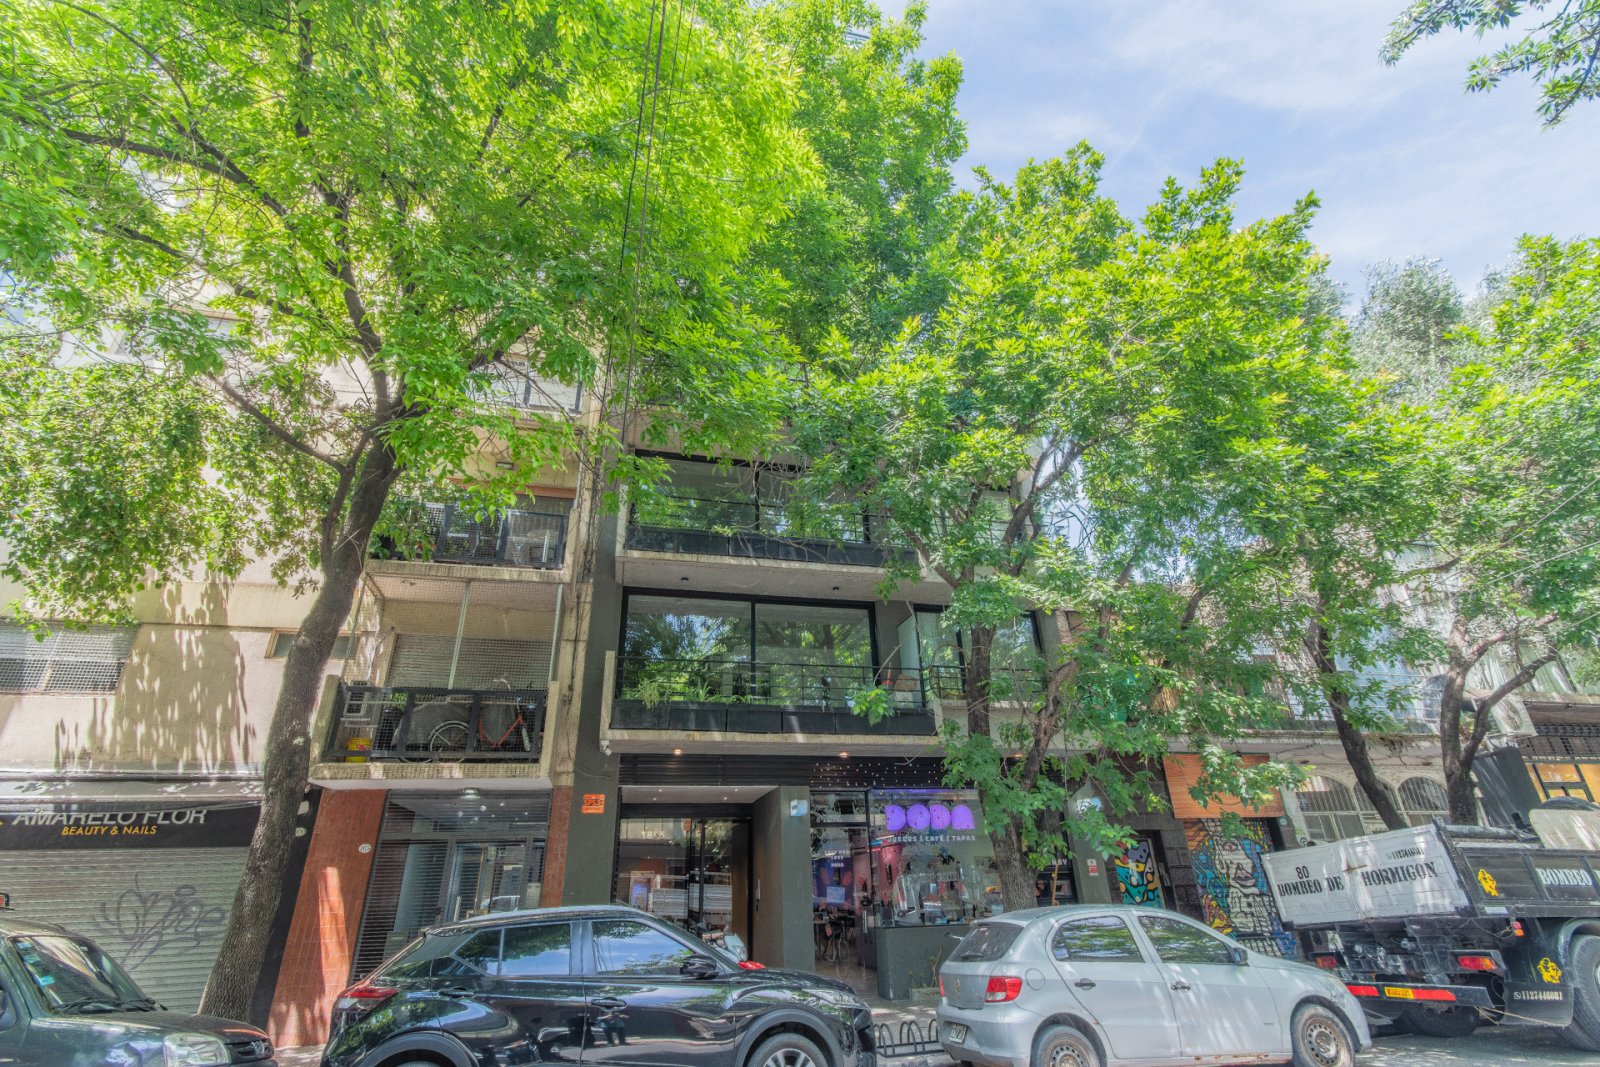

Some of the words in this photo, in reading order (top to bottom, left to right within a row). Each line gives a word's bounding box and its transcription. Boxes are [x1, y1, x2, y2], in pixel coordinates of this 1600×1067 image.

[142, 809, 207, 825] FLOR
[61, 826, 107, 836] BEAUTY
[110, 826, 119, 835] &
[122, 825, 157, 835] NAILS
[1277, 878, 1323, 896] BOMBEO
[1325, 876, 1345, 891] DE
[1361, 861, 1438, 887] HORMIGON
[1295, 865, 1310, 879] 80
[1535, 867, 1593, 886] BOMBEO
